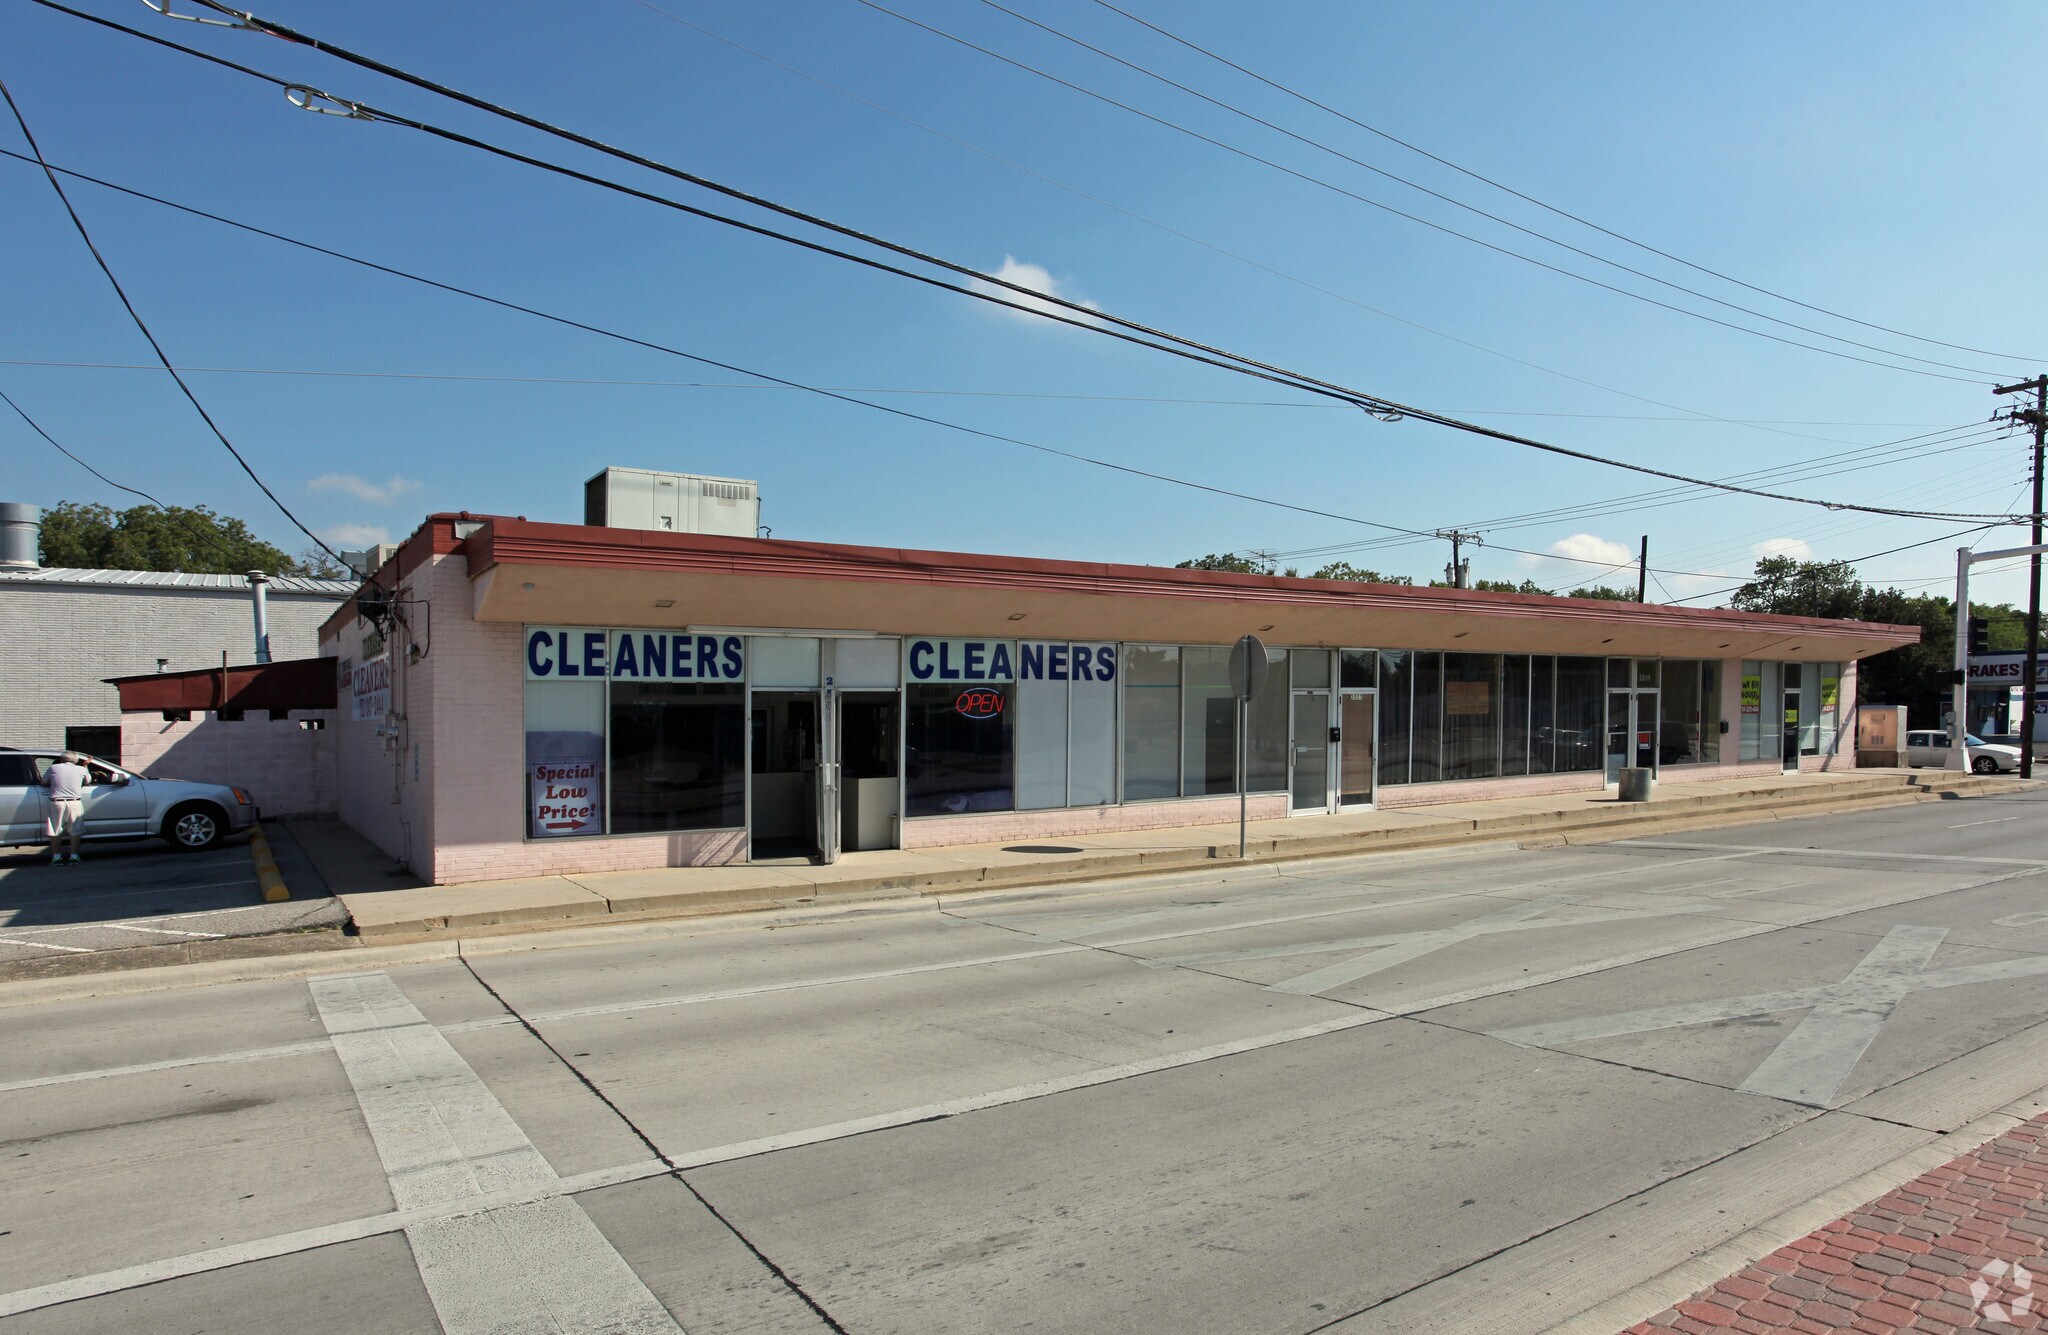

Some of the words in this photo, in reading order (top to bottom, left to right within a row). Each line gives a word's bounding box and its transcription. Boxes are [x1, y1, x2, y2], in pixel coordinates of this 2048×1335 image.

[528, 631, 742, 678] CLEANERS
[910, 640, 1115, 681] CLEANERS
[1967, 663, 2020, 677] RAKES
[956, 693, 1005, 713] OPEN
[536, 764, 596, 783] Special
[545, 785, 587, 800] Low
[537, 803, 596, 820] Price!
